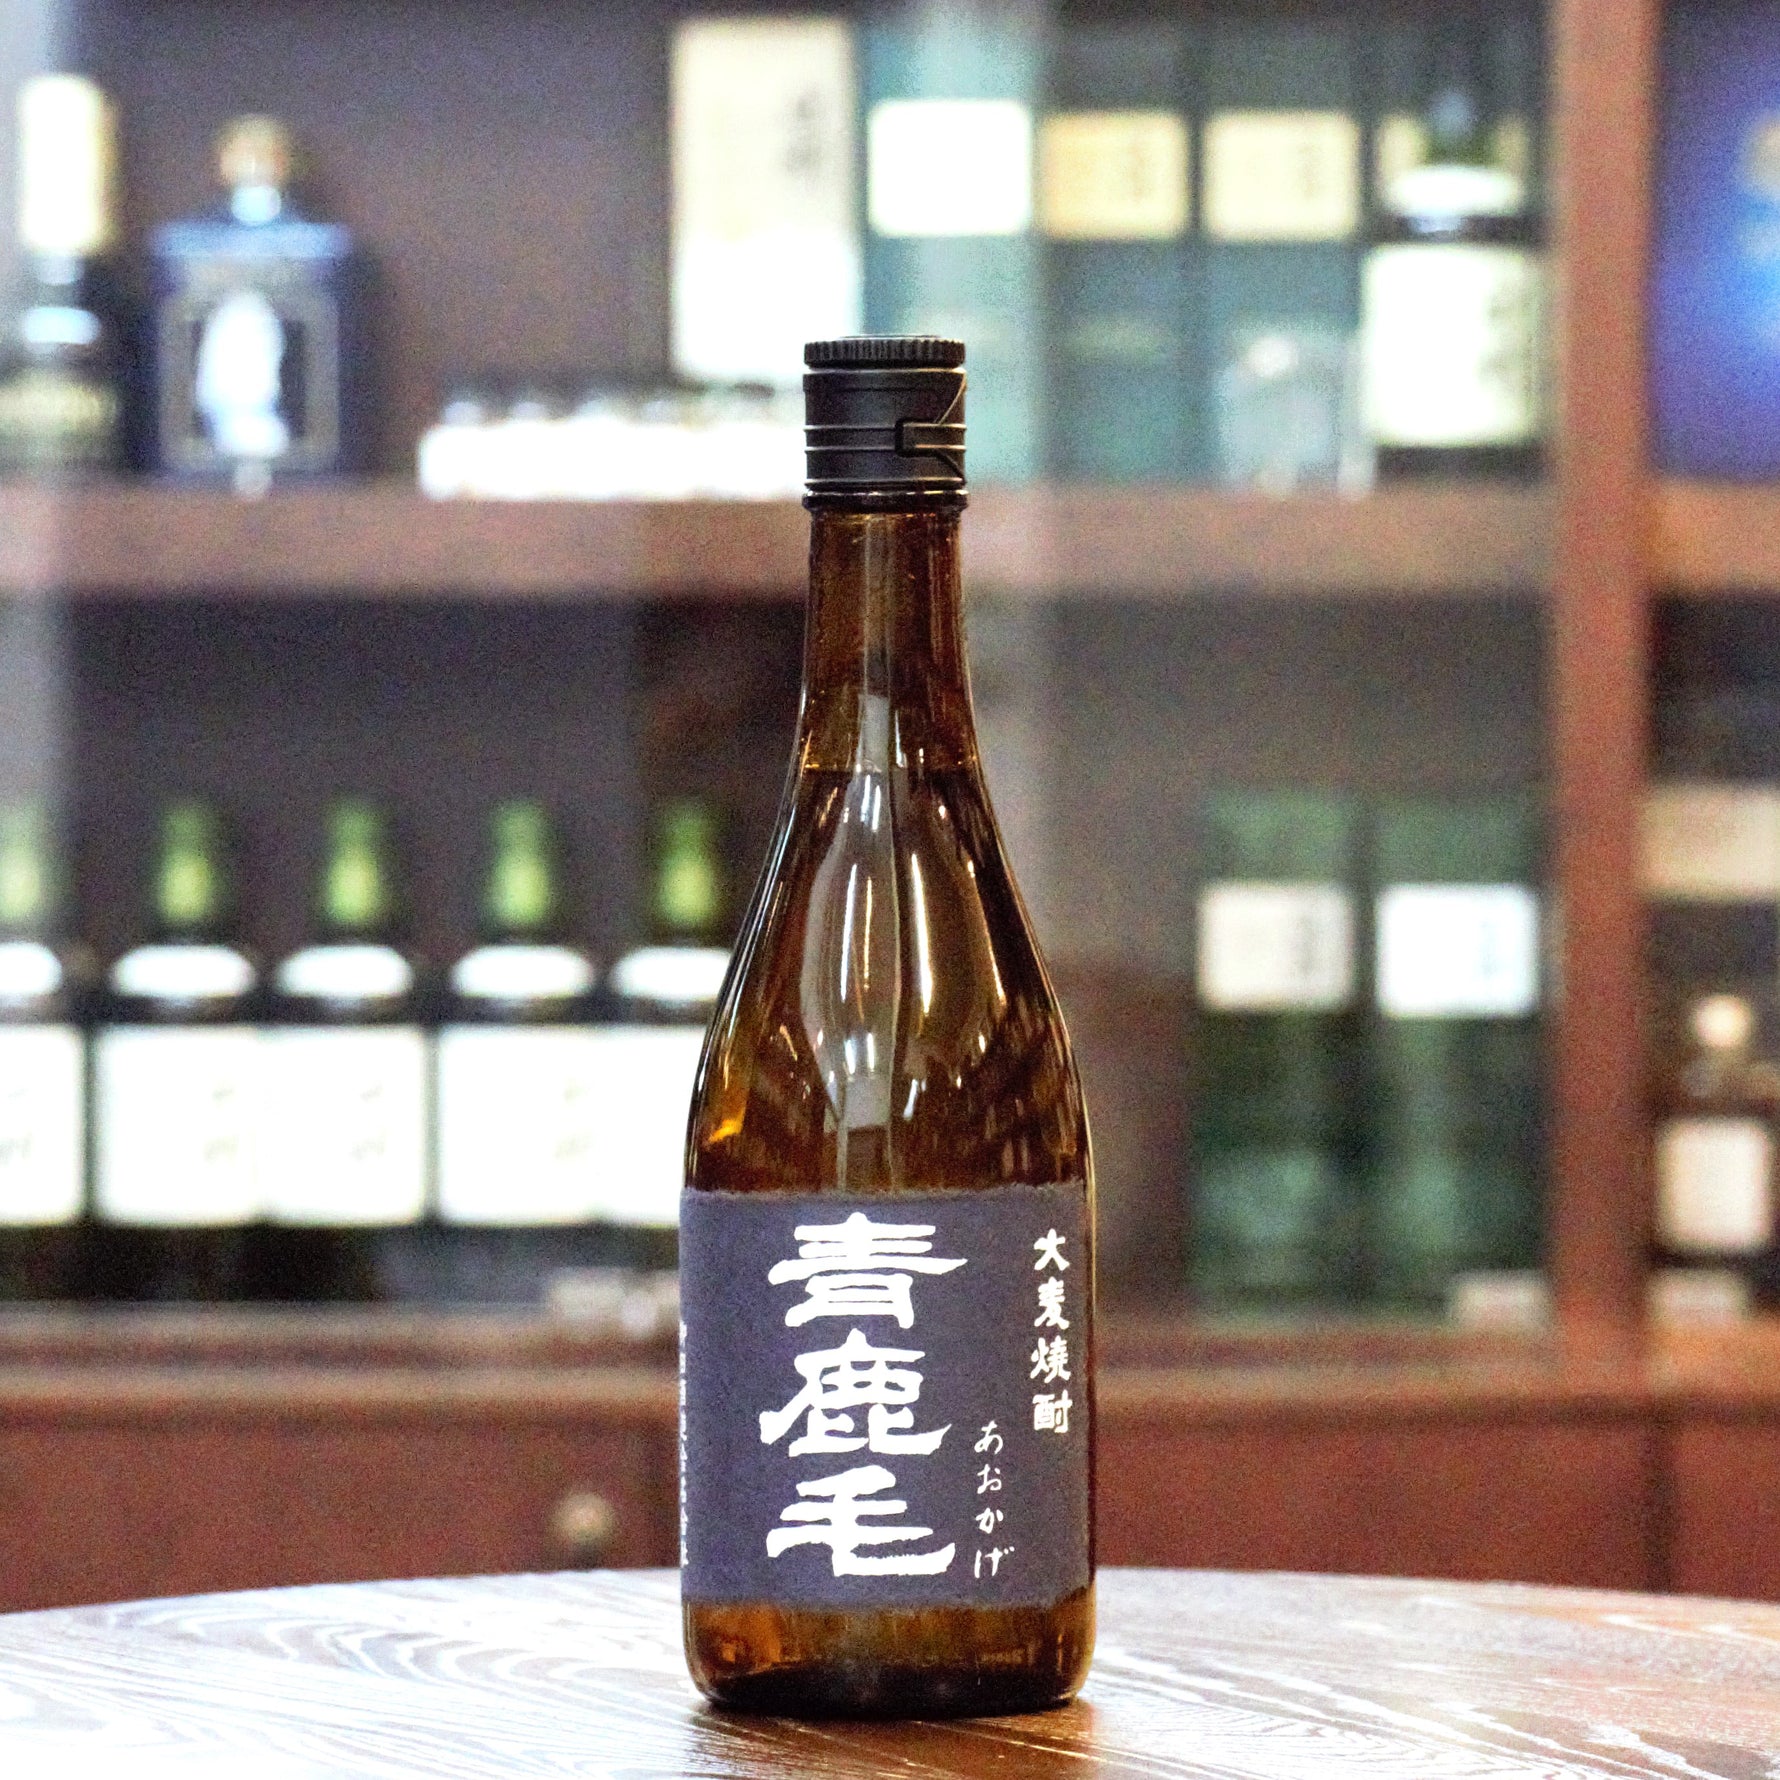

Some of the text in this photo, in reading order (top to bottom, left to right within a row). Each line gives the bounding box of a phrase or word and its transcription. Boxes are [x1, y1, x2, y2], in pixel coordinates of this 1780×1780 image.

[760, 1212, 967, 1577] 青鹿毛
[974, 1421, 1014, 1578] あおかげ
